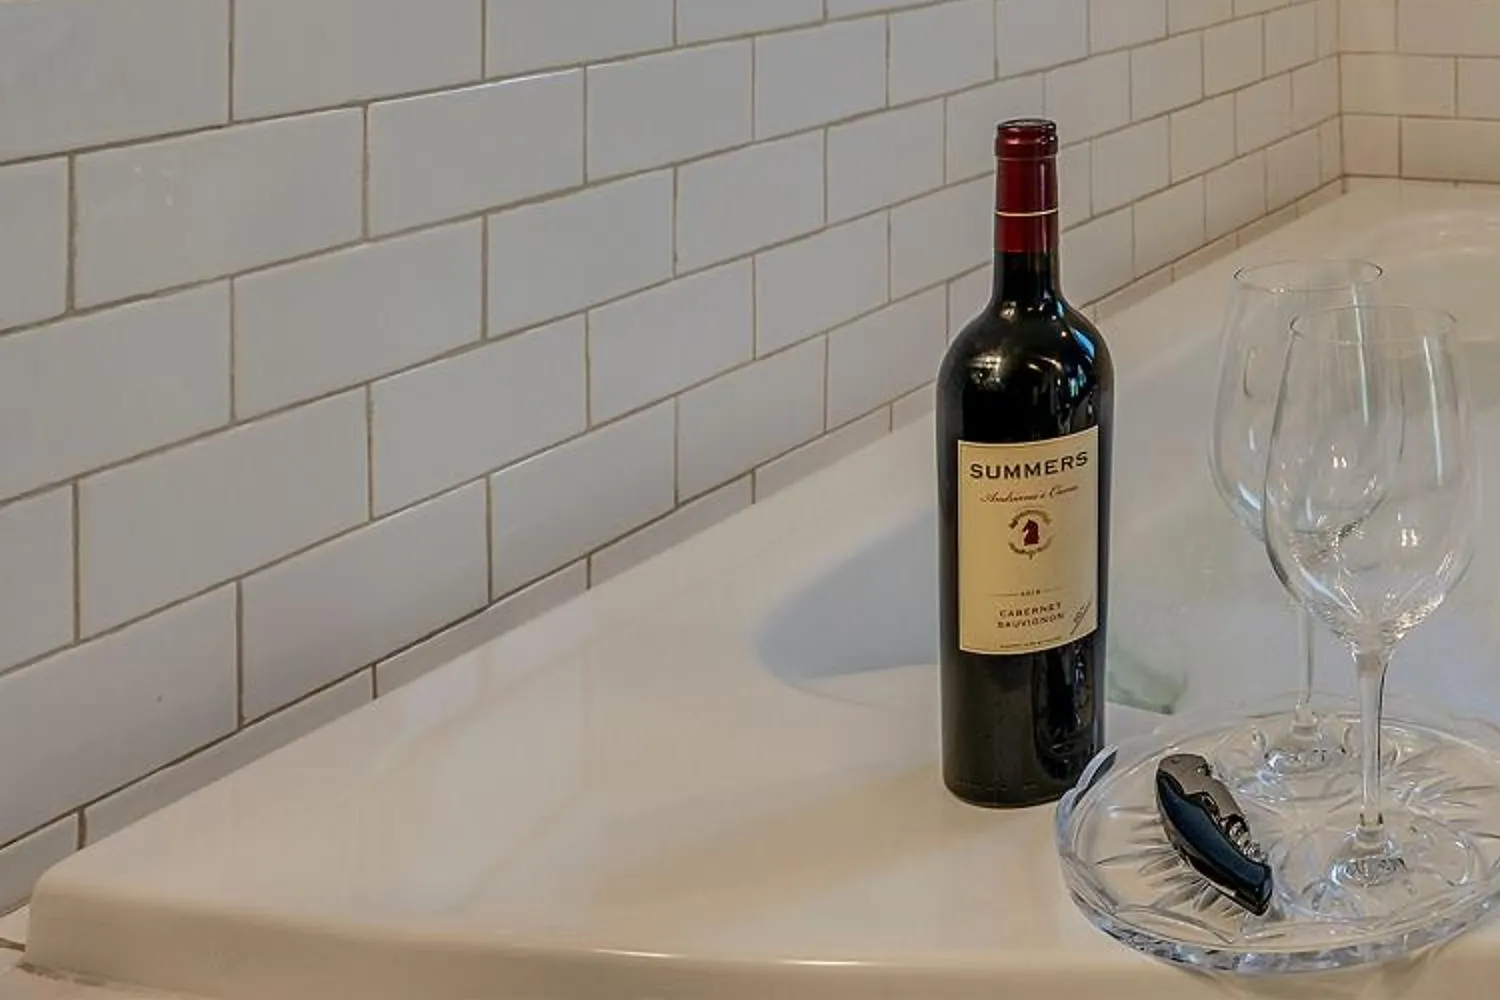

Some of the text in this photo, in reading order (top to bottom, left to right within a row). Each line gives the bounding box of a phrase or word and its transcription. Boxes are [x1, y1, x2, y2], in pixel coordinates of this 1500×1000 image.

[970, 451, 1088, 479] SUMMERS
[999, 601, 1062, 617] CABERNET
[997, 612, 1064, 629] SAUVIGNON
